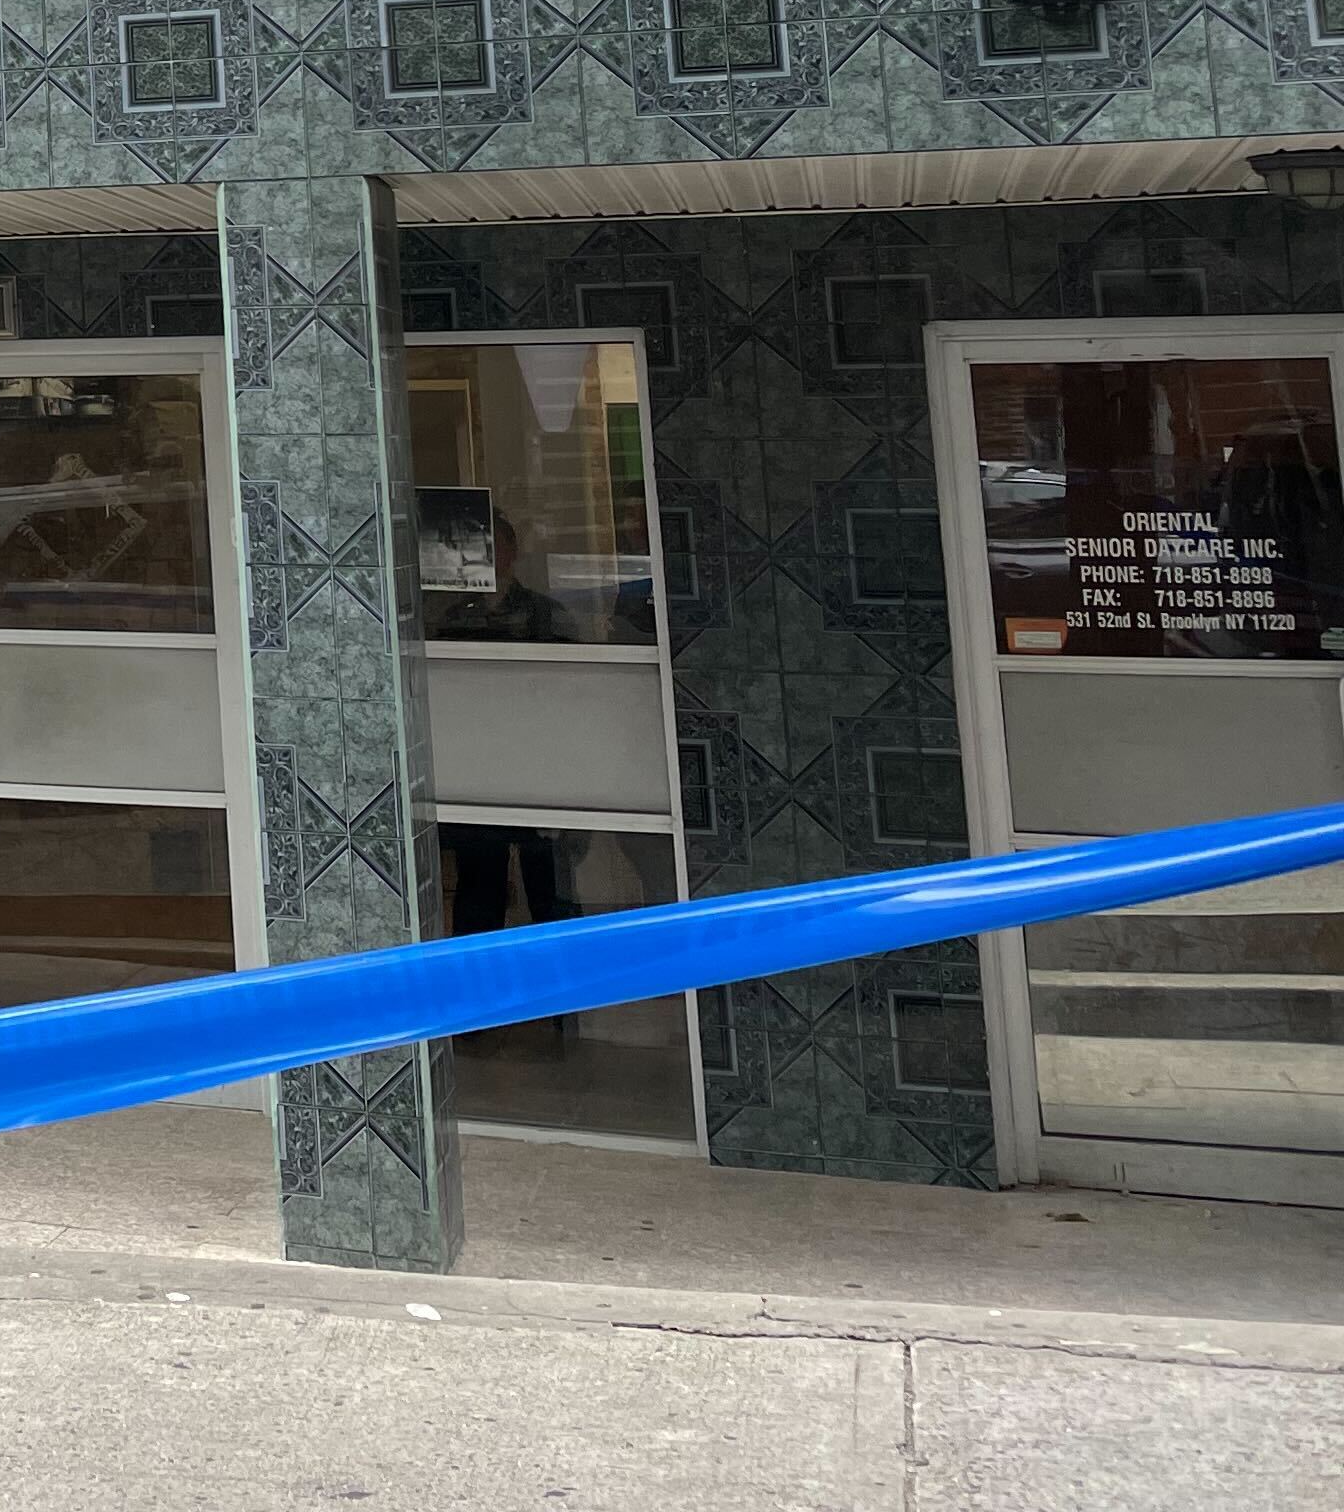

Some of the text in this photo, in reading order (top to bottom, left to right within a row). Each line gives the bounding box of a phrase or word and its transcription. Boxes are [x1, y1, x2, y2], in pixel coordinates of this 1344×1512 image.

[1123, 512, 1218, 532] ORIENTAL
[1064, 538, 1136, 558] SENIOR
[1244, 538, 1284, 558] INC.
[1080, 565, 1273, 584] PHONE: 718-851-8898
[1082, 588, 1276, 608] FAX: 718-851-8896
[1066, 611, 1091, 628] 531
[1097, 612, 1131, 629] 52nd
[1137, 612, 1155, 629] St.
[1161, 613, 1220, 633] Brooklyn
[1225, 613, 1246, 630] NY
